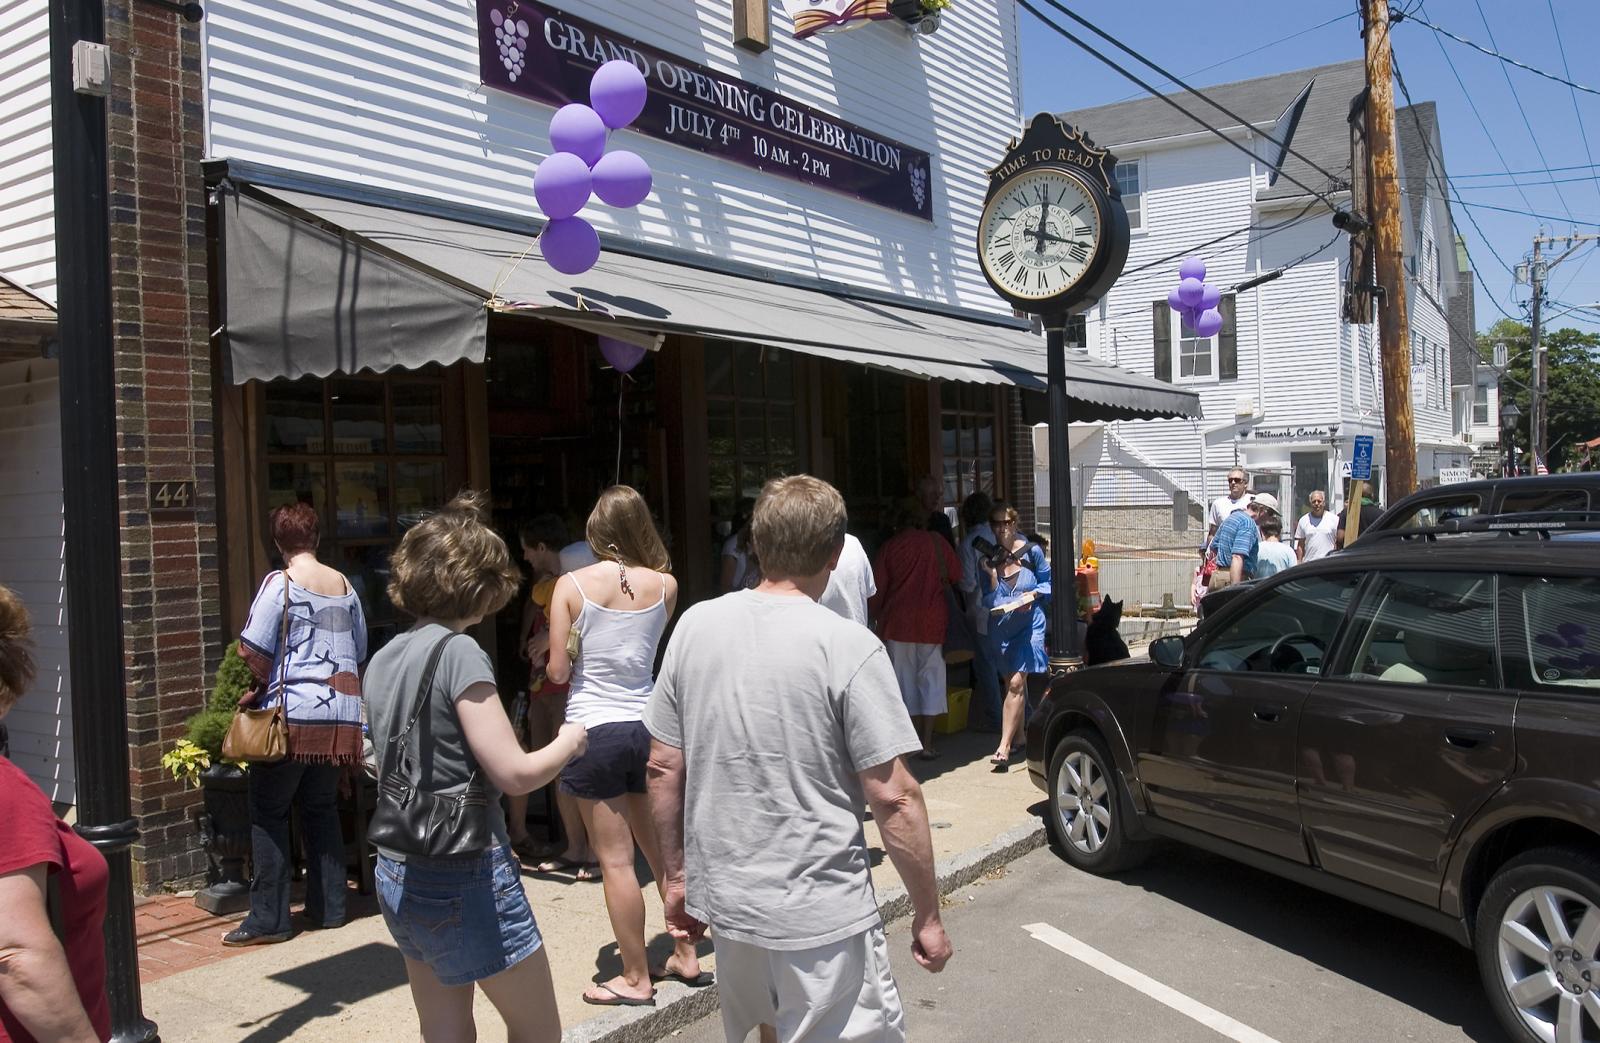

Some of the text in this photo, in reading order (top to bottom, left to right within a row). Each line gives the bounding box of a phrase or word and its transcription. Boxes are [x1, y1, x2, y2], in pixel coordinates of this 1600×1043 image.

[544, 17, 900, 171] GRAND OPENING CELEBRATION
[665, 103, 715, 140] JULY
[719, 122, 740, 146] 4TH
[752, 135, 767, 158] 10
[770, 145, 790, 165] AM
[801, 152, 810, 173] 2
[812, 159, 830, 178] PM
[995, 148, 1094, 181] TIME TO READ
[1255, 427, 1327, 440] Hallmark Cards
[155, 483, 189, 508] 44
